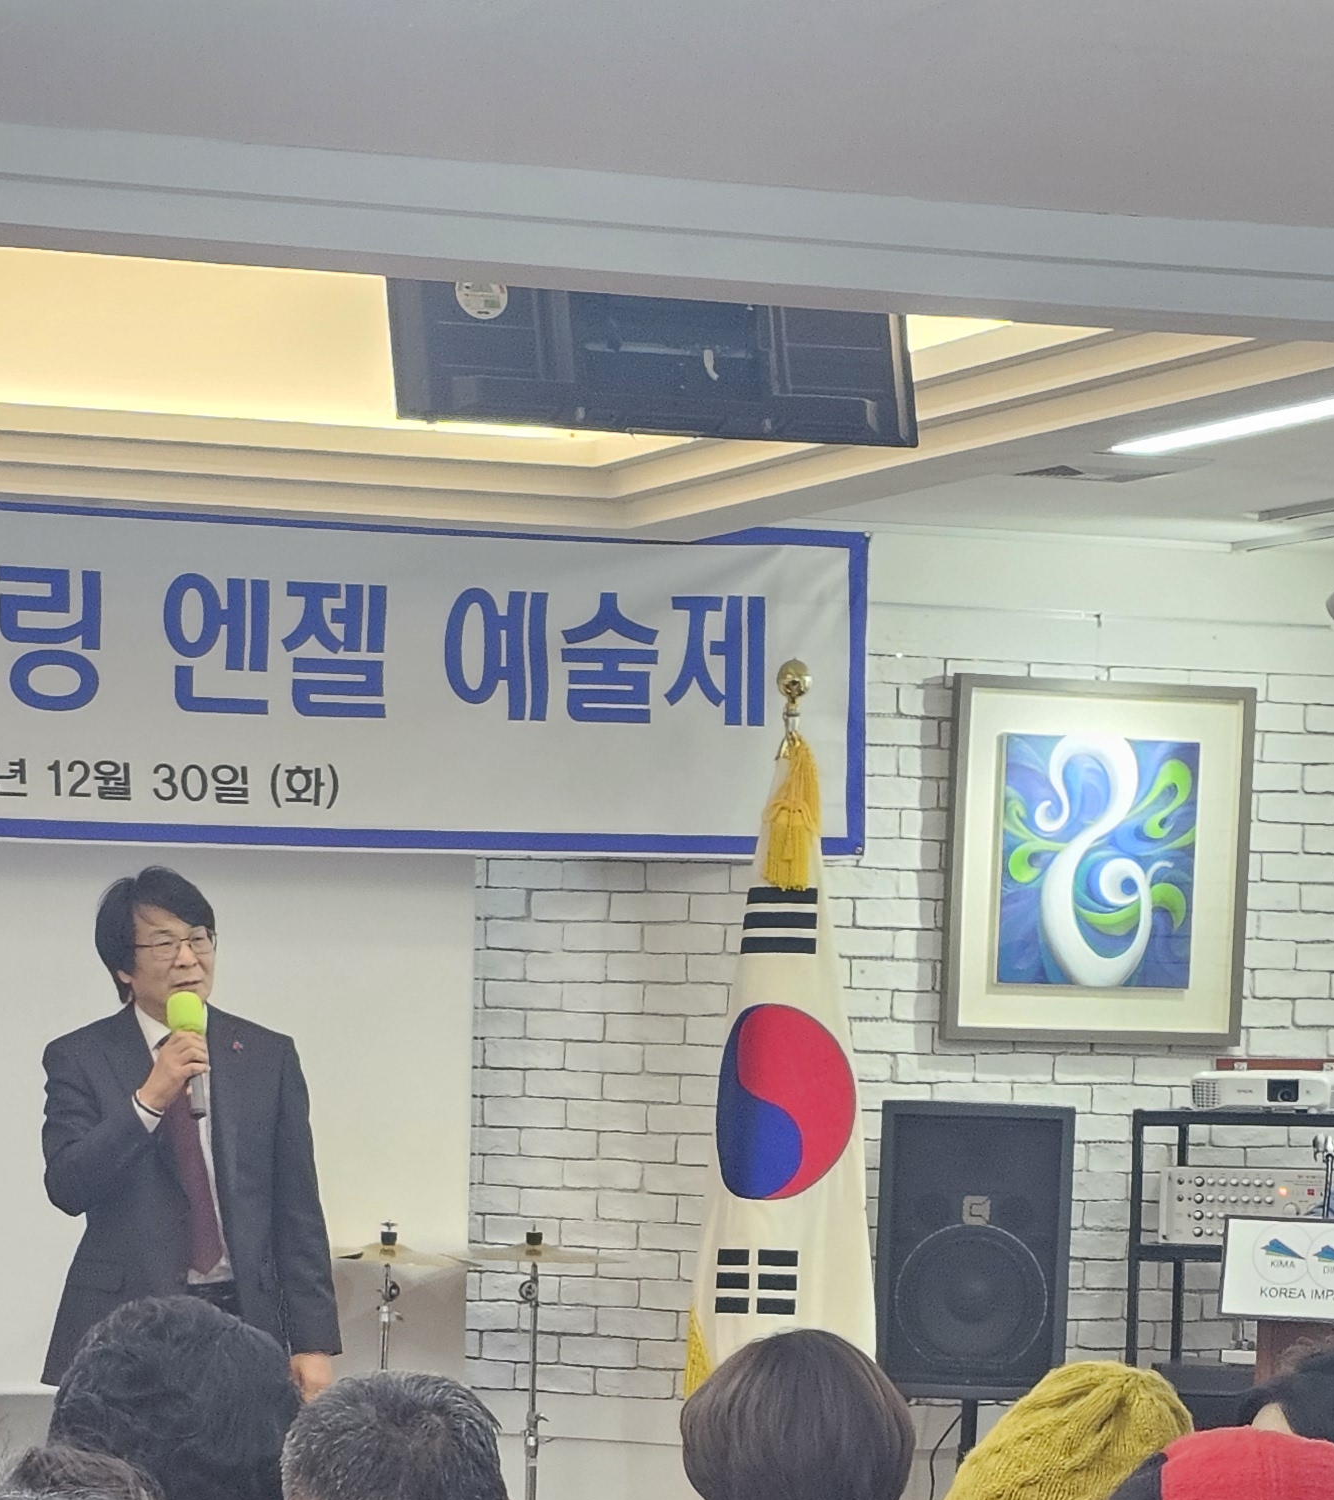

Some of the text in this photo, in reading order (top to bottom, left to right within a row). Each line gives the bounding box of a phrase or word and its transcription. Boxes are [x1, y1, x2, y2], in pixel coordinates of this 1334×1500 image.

[163, 572, 388, 719] 엔젤
[444, 587, 766, 727] 예술제
[47, 759, 132, 801] 12월
[151, 763, 250, 805] 30일
[270, 763, 341, 810] (화)
[1270, 1260, 1296, 1269] KIMA
[1259, 1286, 1306, 1300] KOREA
